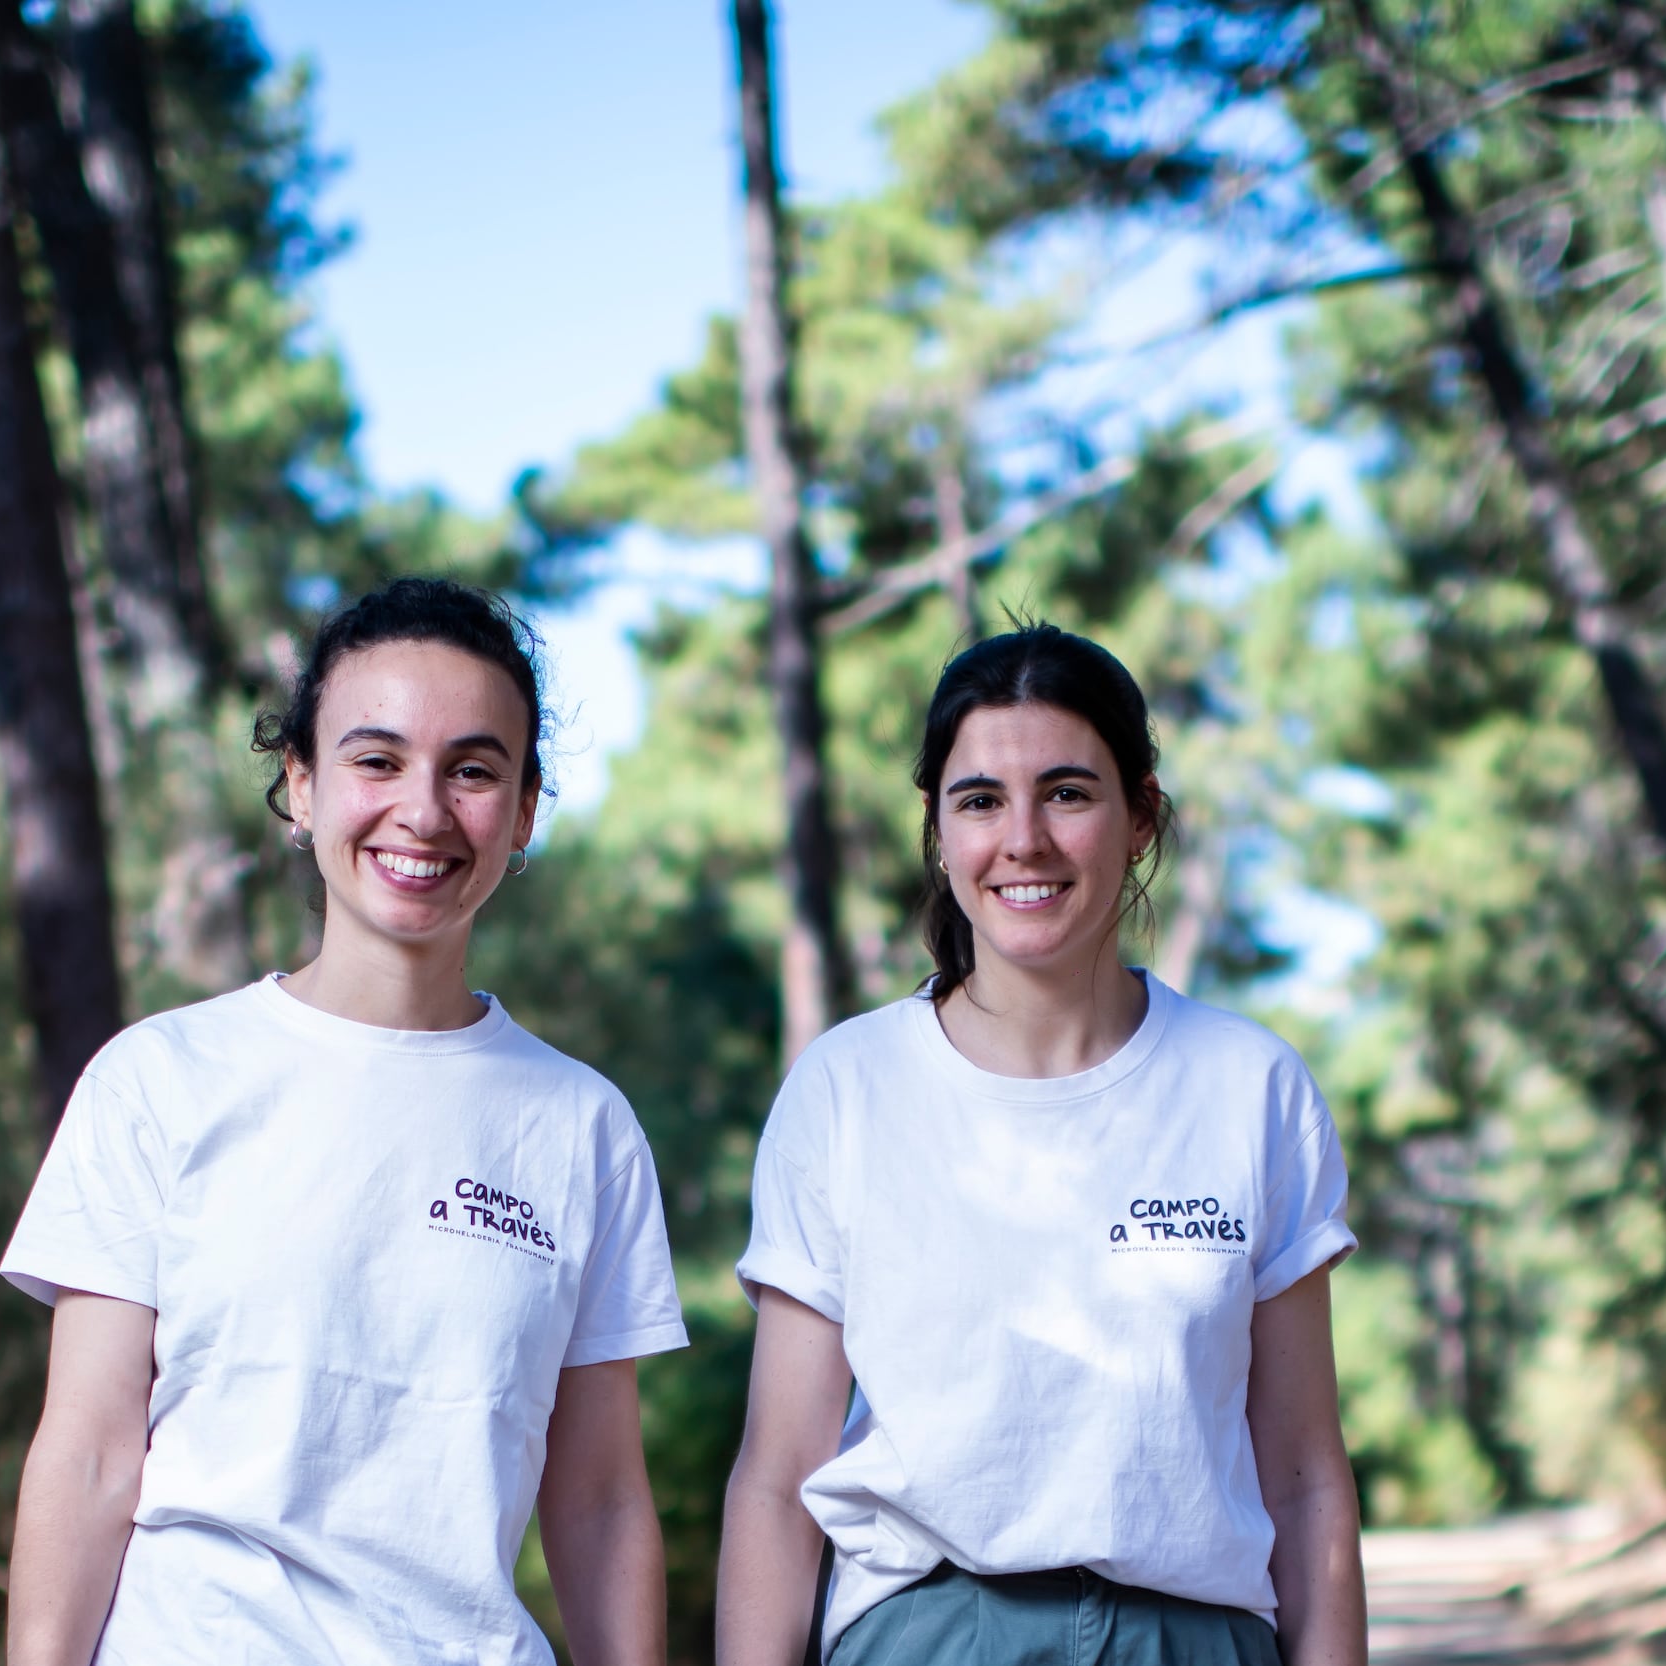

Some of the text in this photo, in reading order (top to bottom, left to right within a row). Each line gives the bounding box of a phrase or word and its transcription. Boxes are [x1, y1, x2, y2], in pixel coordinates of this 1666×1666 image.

[430, 1199, 448, 1221] a
[1110, 1224, 1128, 1242] a
[506, 1241, 555, 1266] TRASHUMANTE
[1191, 1246, 1246, 1256] TRASHUMANTE
